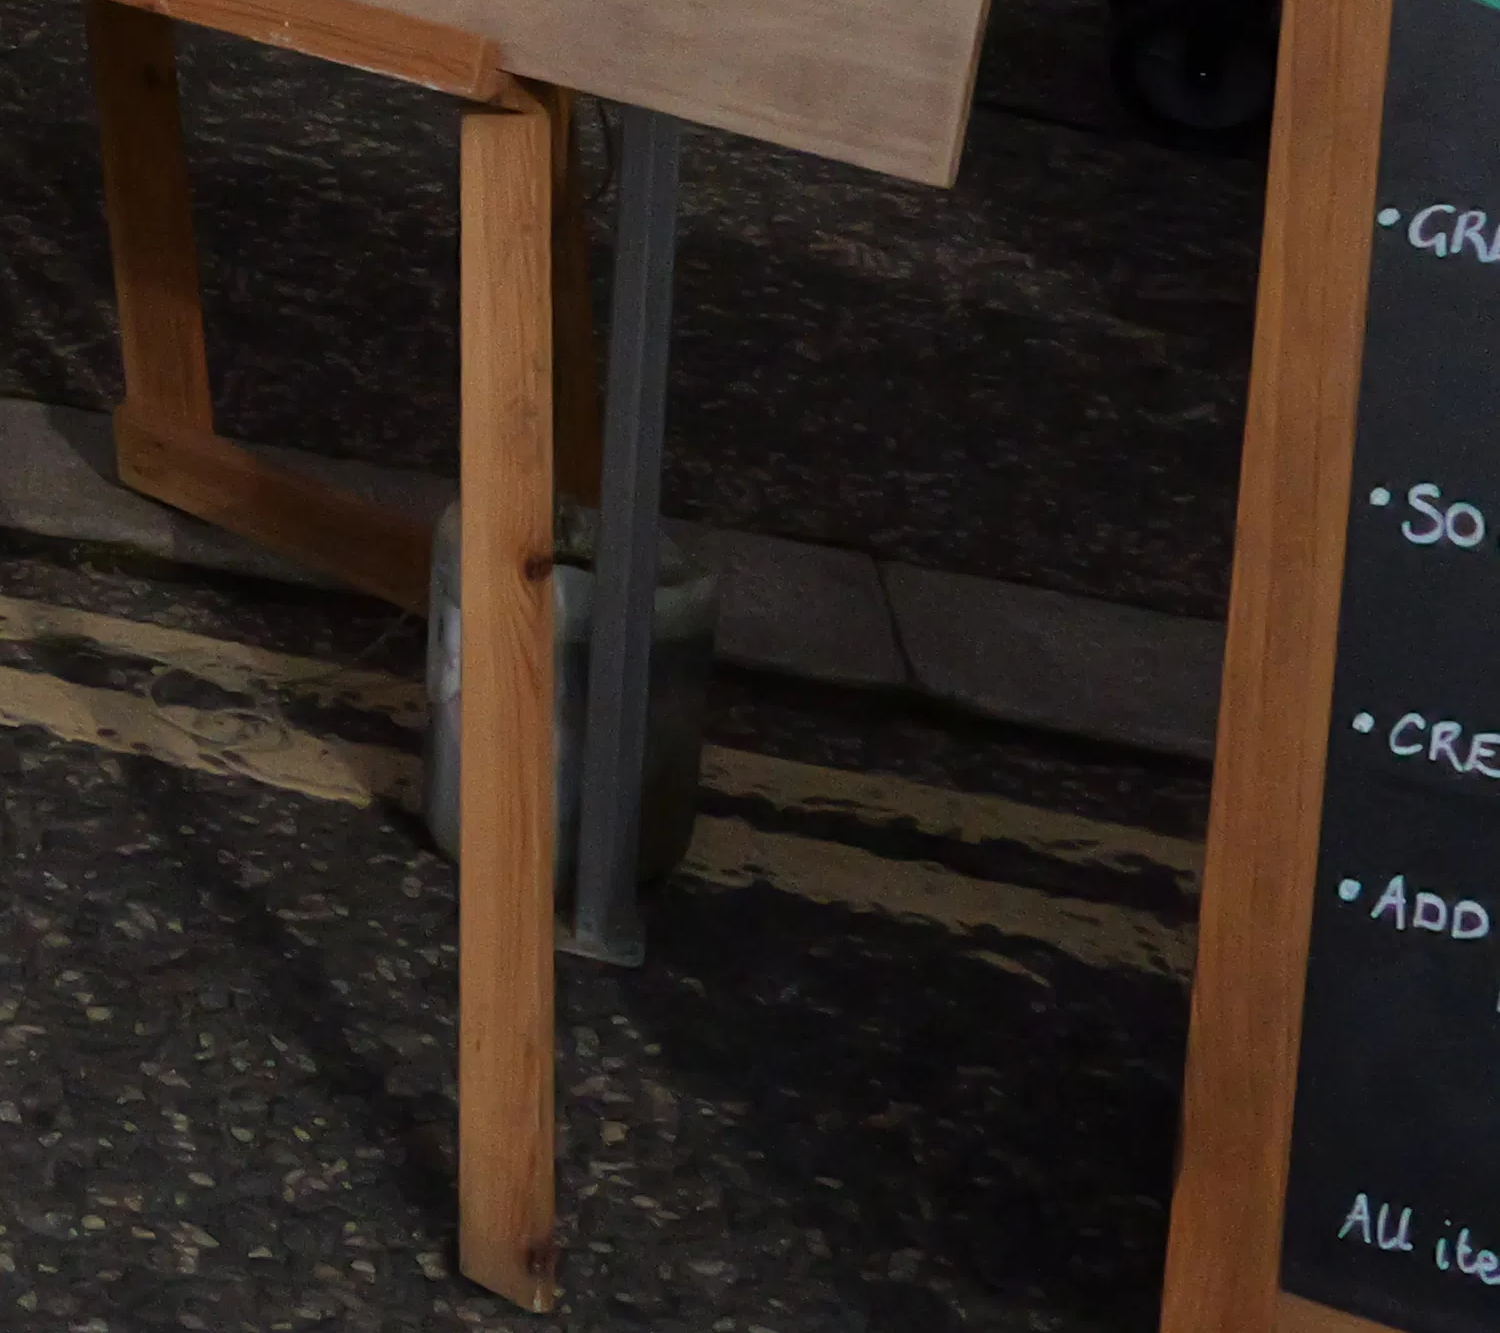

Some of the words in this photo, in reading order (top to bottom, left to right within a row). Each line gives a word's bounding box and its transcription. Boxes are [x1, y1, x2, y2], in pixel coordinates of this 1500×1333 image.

[1401, 482, 1486, 548] SO
[1371, 874, 1490, 940] ADD
[1337, 1193, 1414, 1252] All
